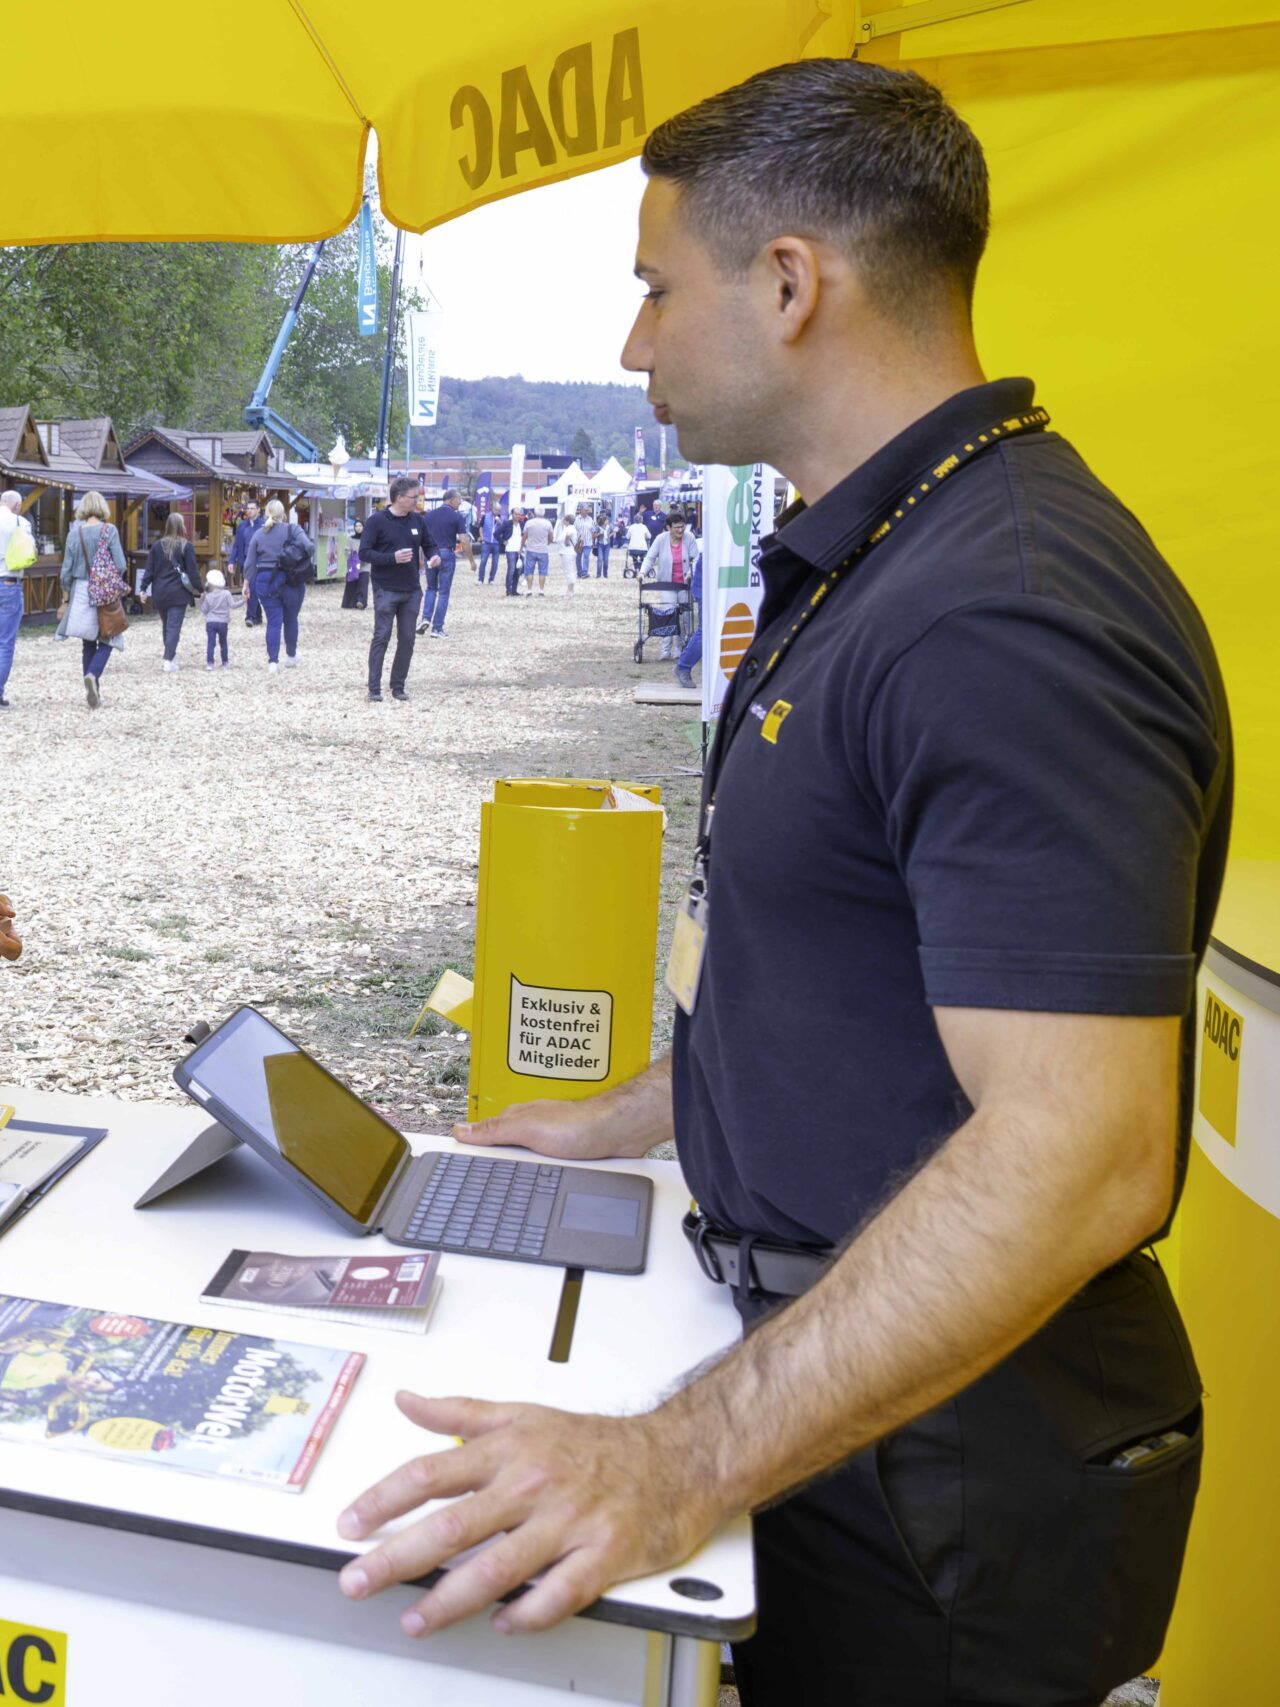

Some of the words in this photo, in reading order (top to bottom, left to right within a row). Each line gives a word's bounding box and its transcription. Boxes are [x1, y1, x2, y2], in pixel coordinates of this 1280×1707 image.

[521, 996, 585, 1015] Exklusiv
[589, 1002, 601, 1015] &
[520, 1013, 600, 1033] kostenfrei
[1203, 996, 1241, 1062] ADAC
[519, 1031, 542, 1046] für
[546, 1036, 591, 1050] ADAC
[518, 1049, 600, 1069] Mitglieder
[189, 1347, 282, 1451] MotorWelt
